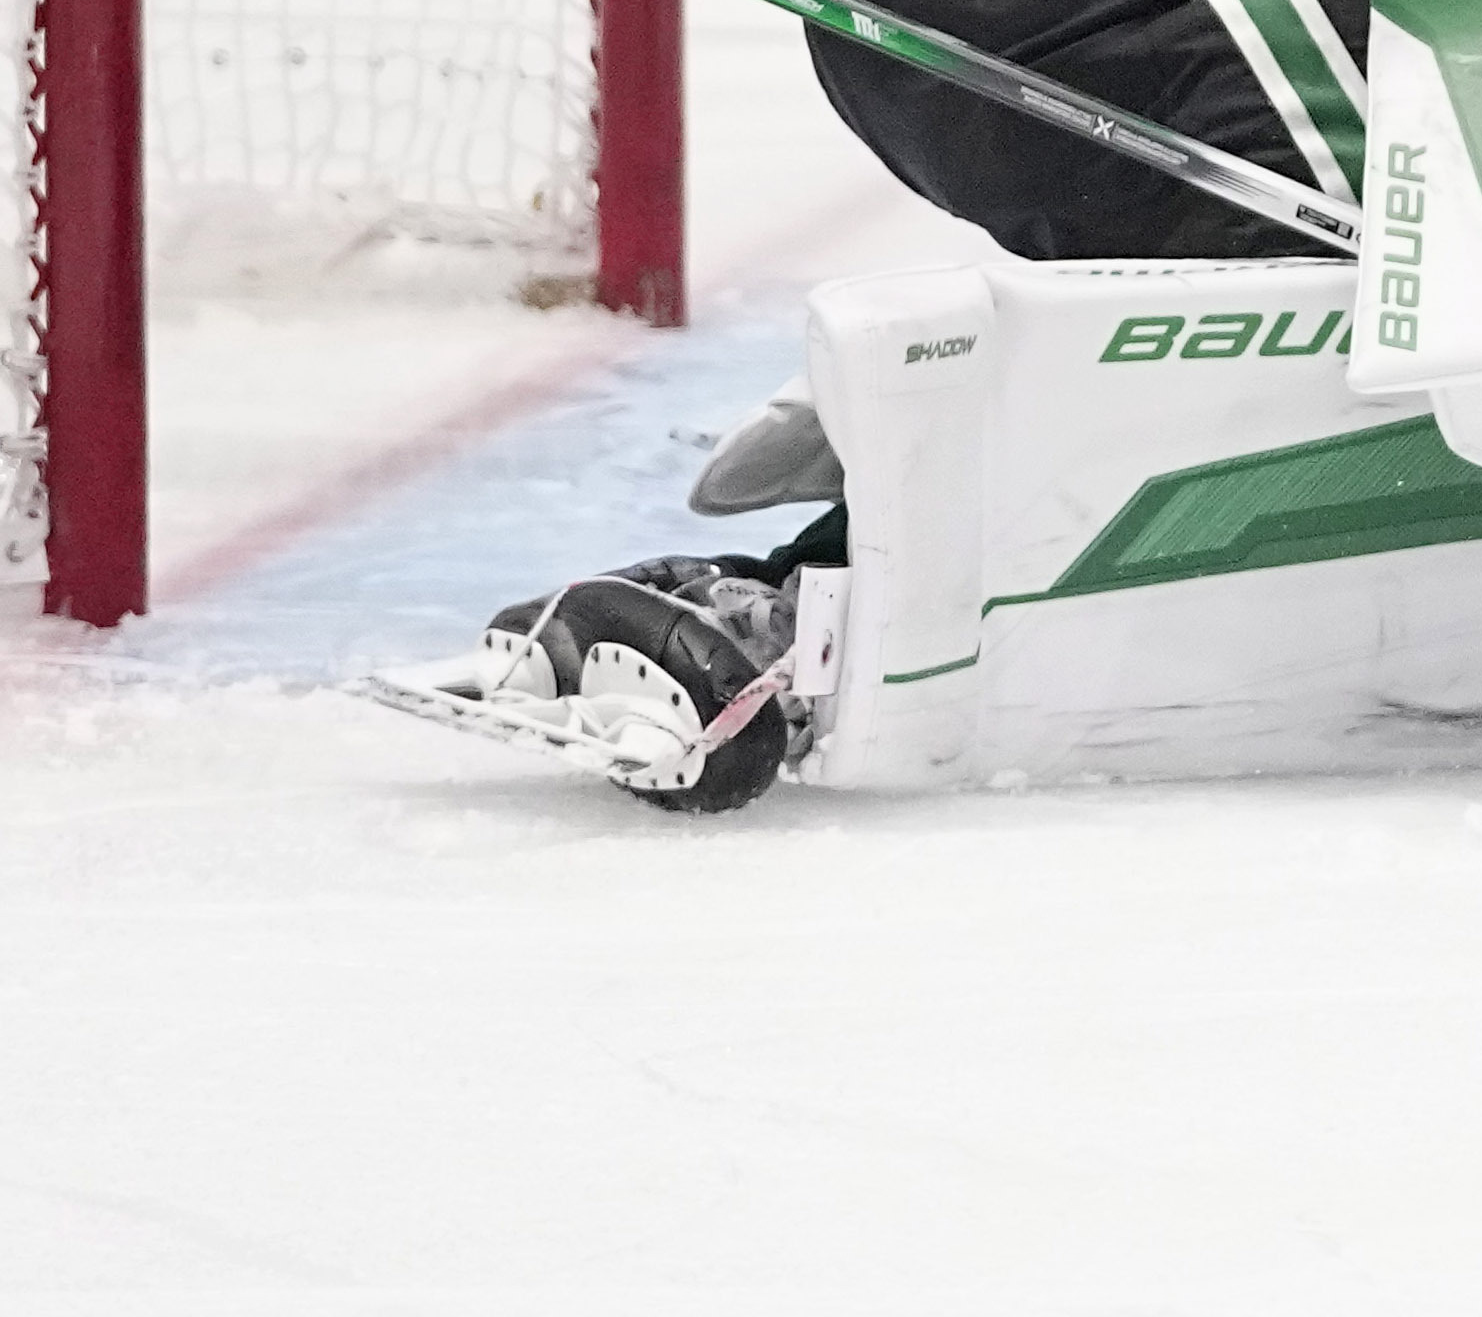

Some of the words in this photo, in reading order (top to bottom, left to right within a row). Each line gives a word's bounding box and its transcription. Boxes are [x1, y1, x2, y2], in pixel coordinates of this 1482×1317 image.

[1378, 142, 1427, 352] BAUER
[904, 334, 978, 365] SHADOW
[1098, 310, 1352, 363] BAU
